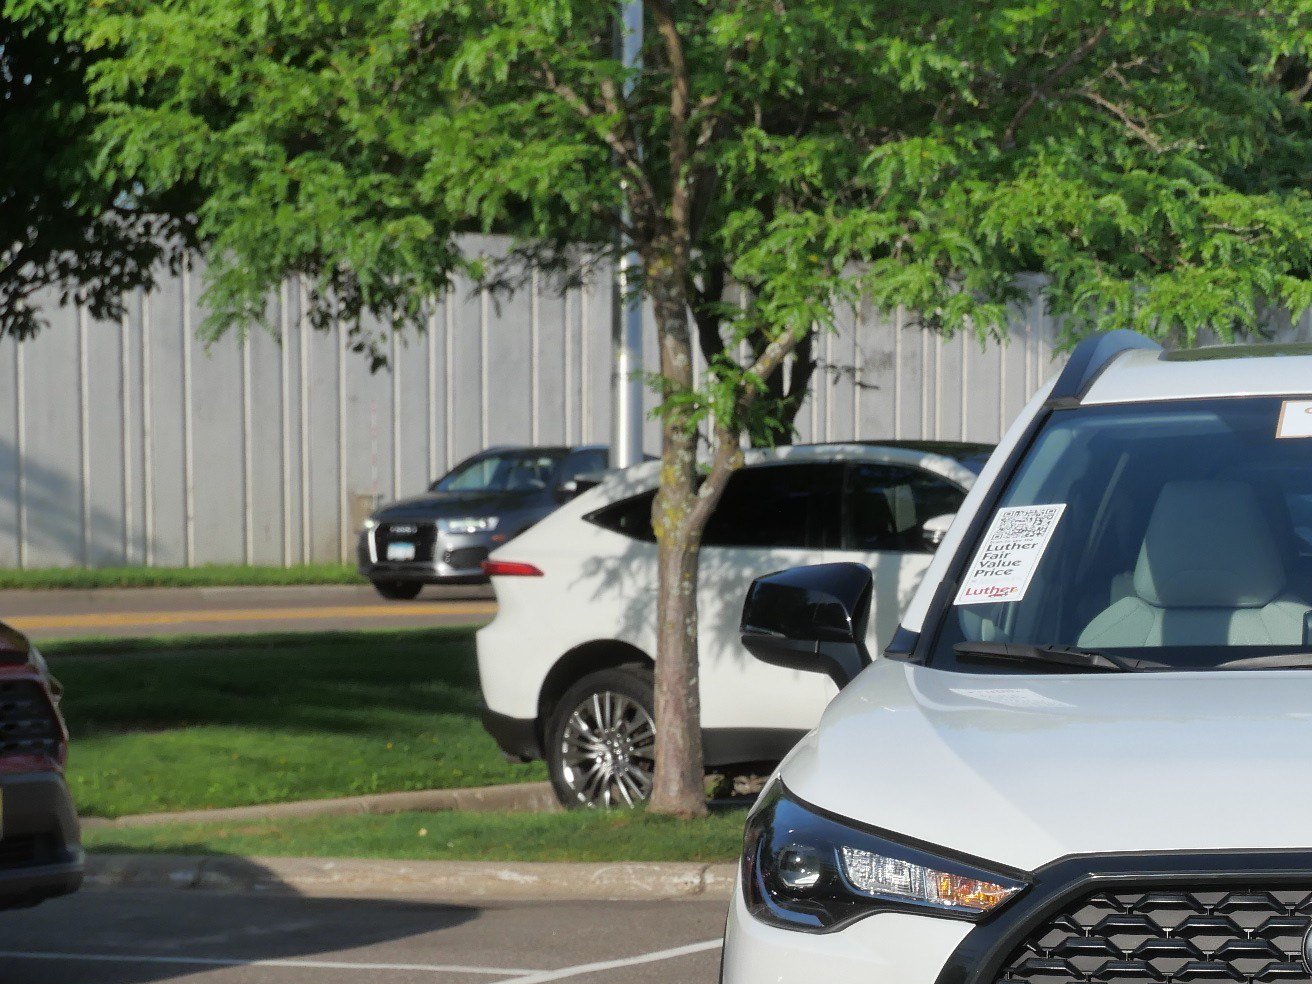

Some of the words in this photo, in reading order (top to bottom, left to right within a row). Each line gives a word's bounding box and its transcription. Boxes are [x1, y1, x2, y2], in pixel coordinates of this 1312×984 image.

[986, 543, 1038, 552] Luther
[982, 552, 1011, 561] Fair
[979, 560, 1022, 568] Value
[974, 568, 1014, 578] Price
[965, 585, 1018, 596] Luther
